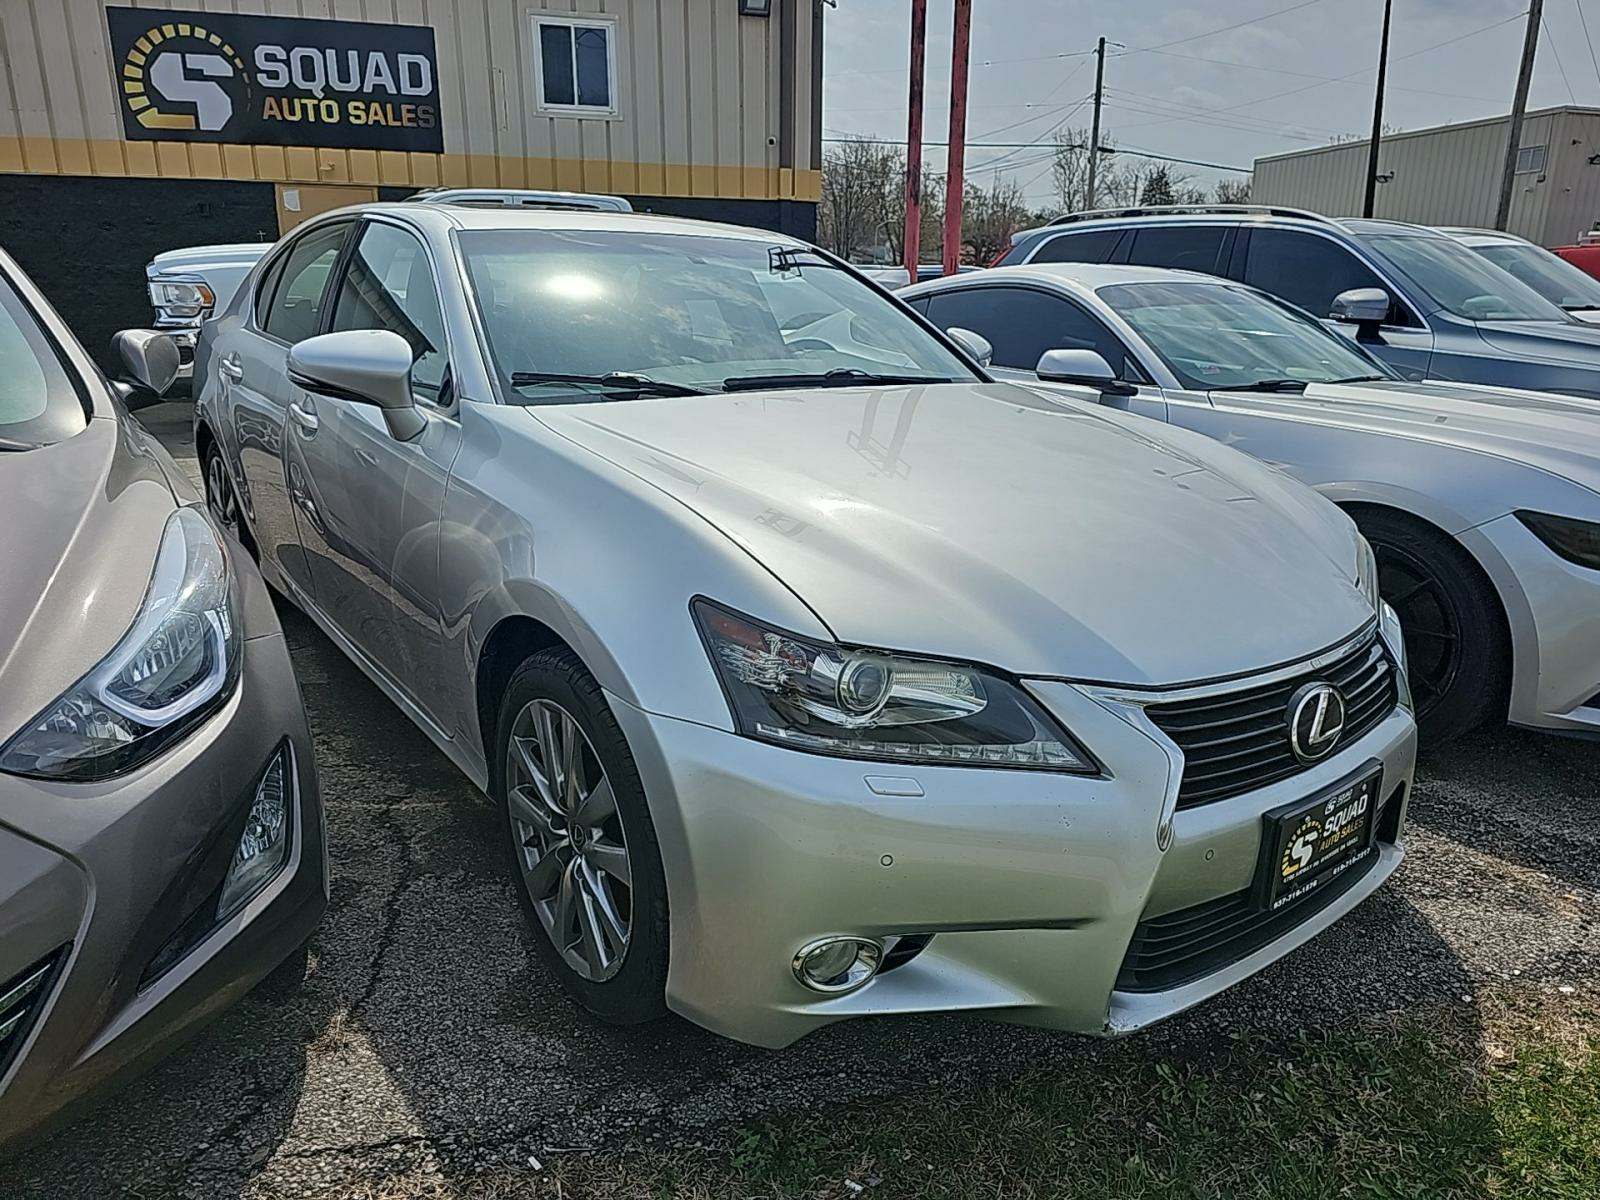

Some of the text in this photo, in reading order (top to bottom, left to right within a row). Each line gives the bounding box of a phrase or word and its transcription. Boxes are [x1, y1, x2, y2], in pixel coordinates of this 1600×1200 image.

[253, 44, 433, 99] SQUAD
[262, 96, 436, 129] AUTO SALES
[1319, 816, 1364, 853] AUTO SALES
[1323, 793, 1368, 837] SQUAD
